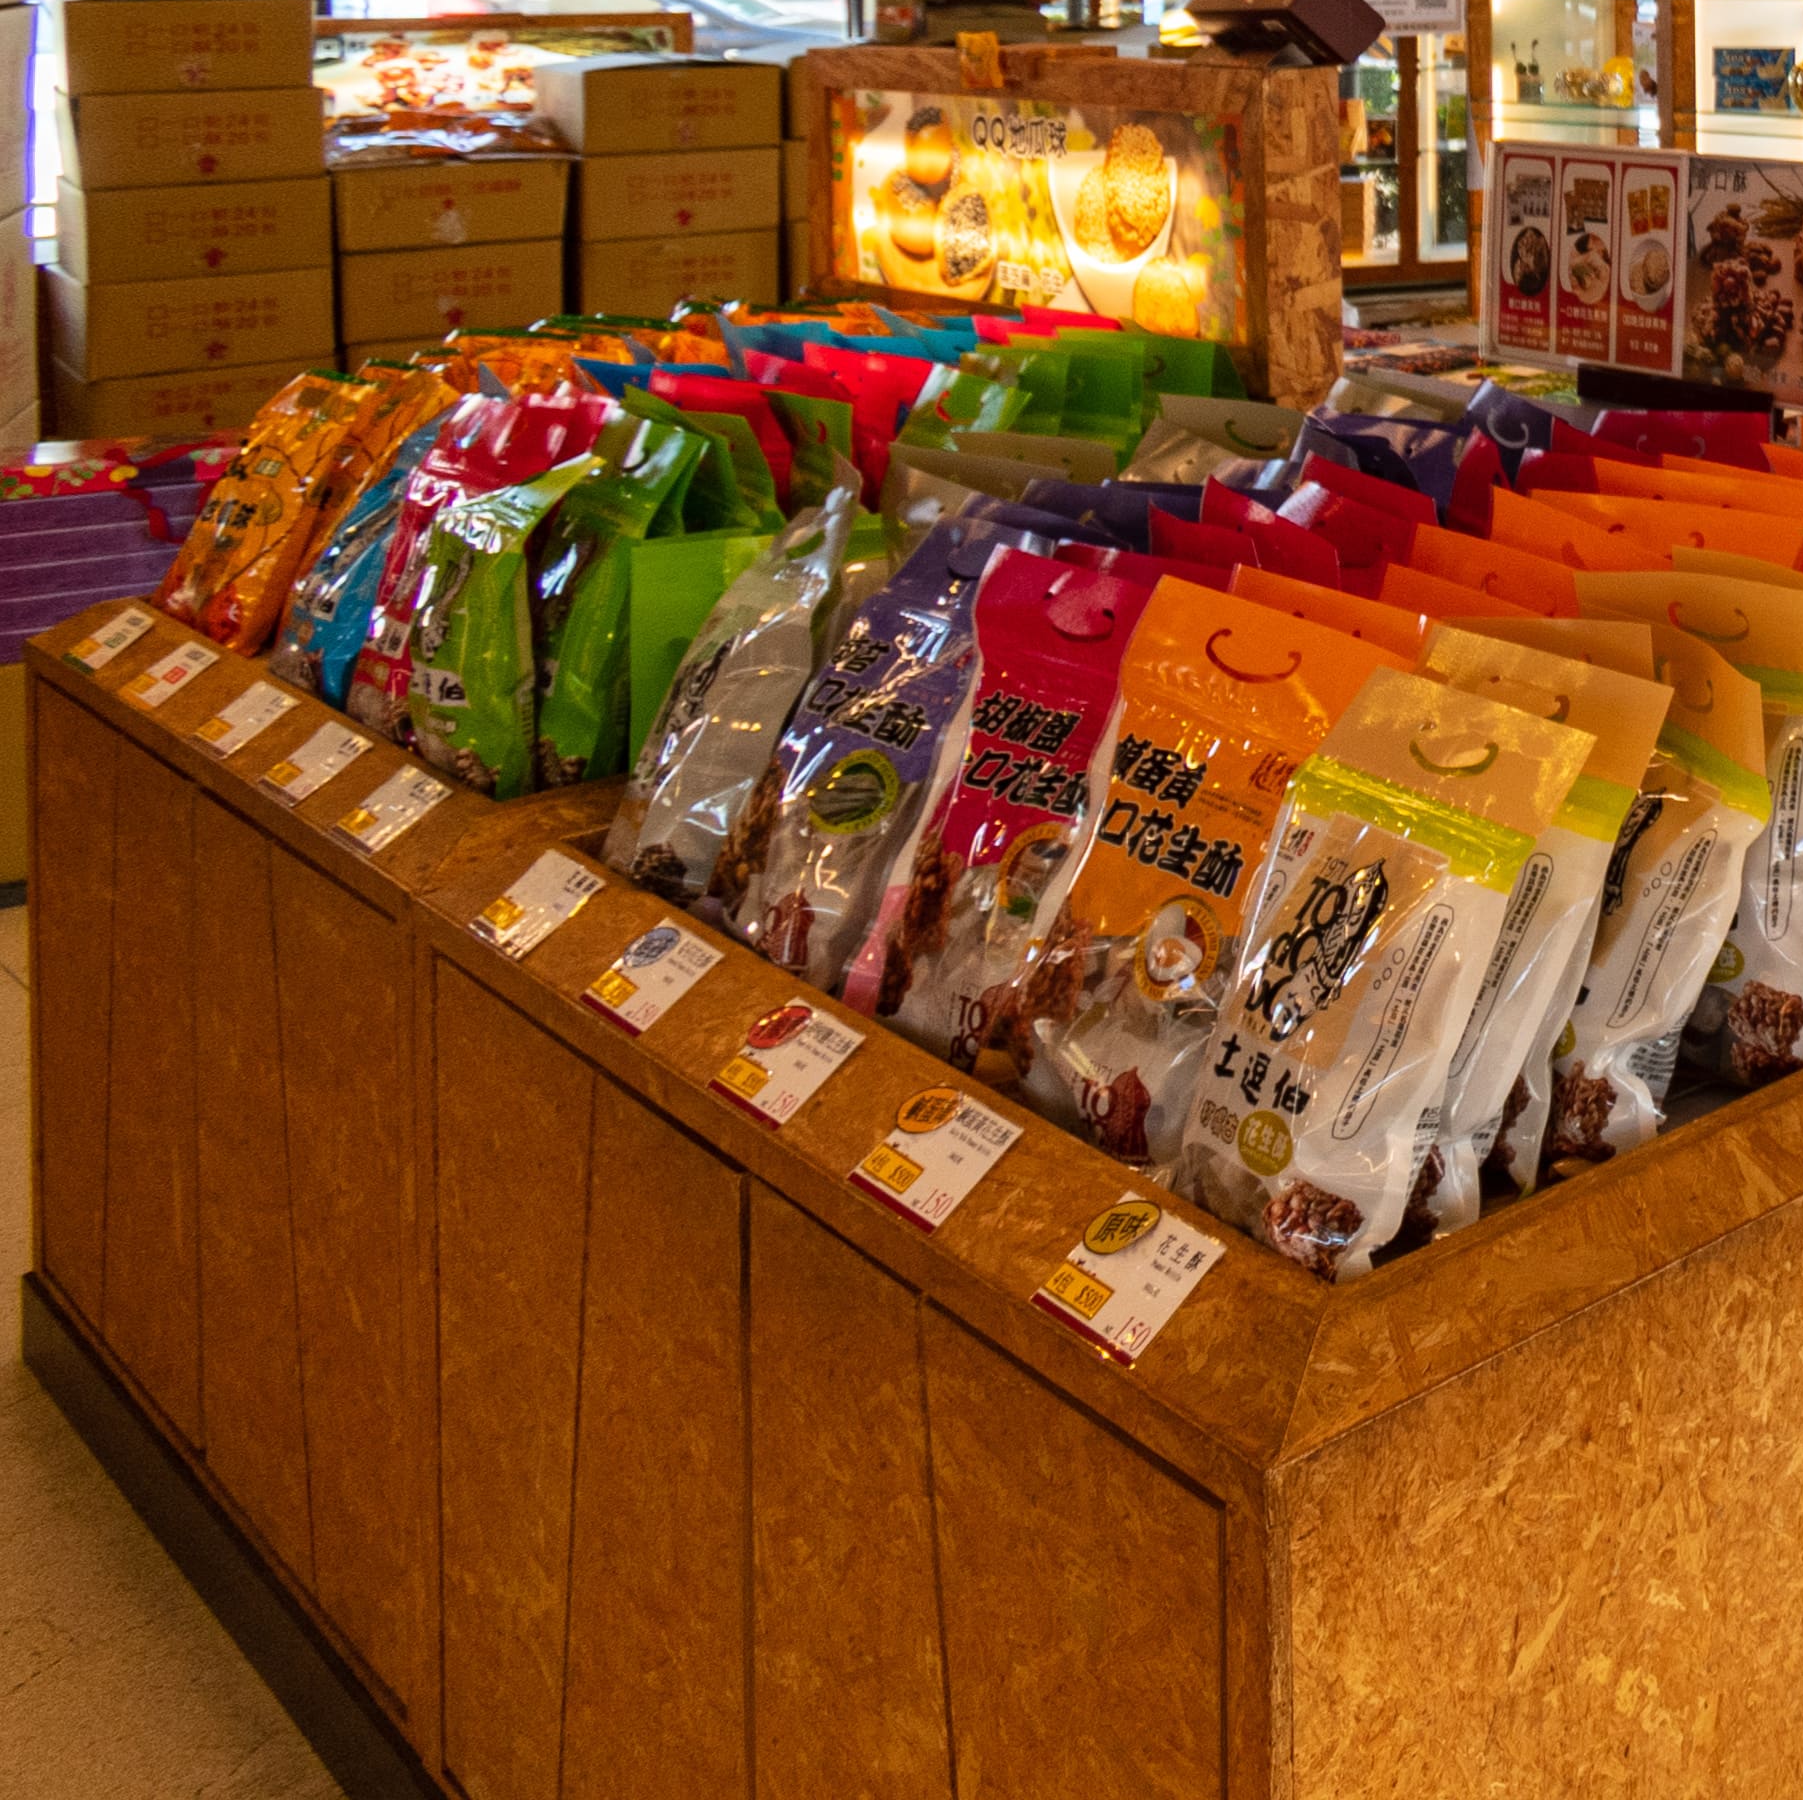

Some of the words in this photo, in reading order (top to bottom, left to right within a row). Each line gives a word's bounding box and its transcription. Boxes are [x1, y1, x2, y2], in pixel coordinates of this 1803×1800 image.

[973, 115, 1068, 157] QQ地瓜球
[1213, 1032, 1311, 1115] 土逗伯
[919, 1188, 953, 1219] 150
[1091, 1211, 1151, 1243] 原味
[1156, 1234, 1207, 1272] 花生酥
[1113, 1316, 1151, 1351] 150
